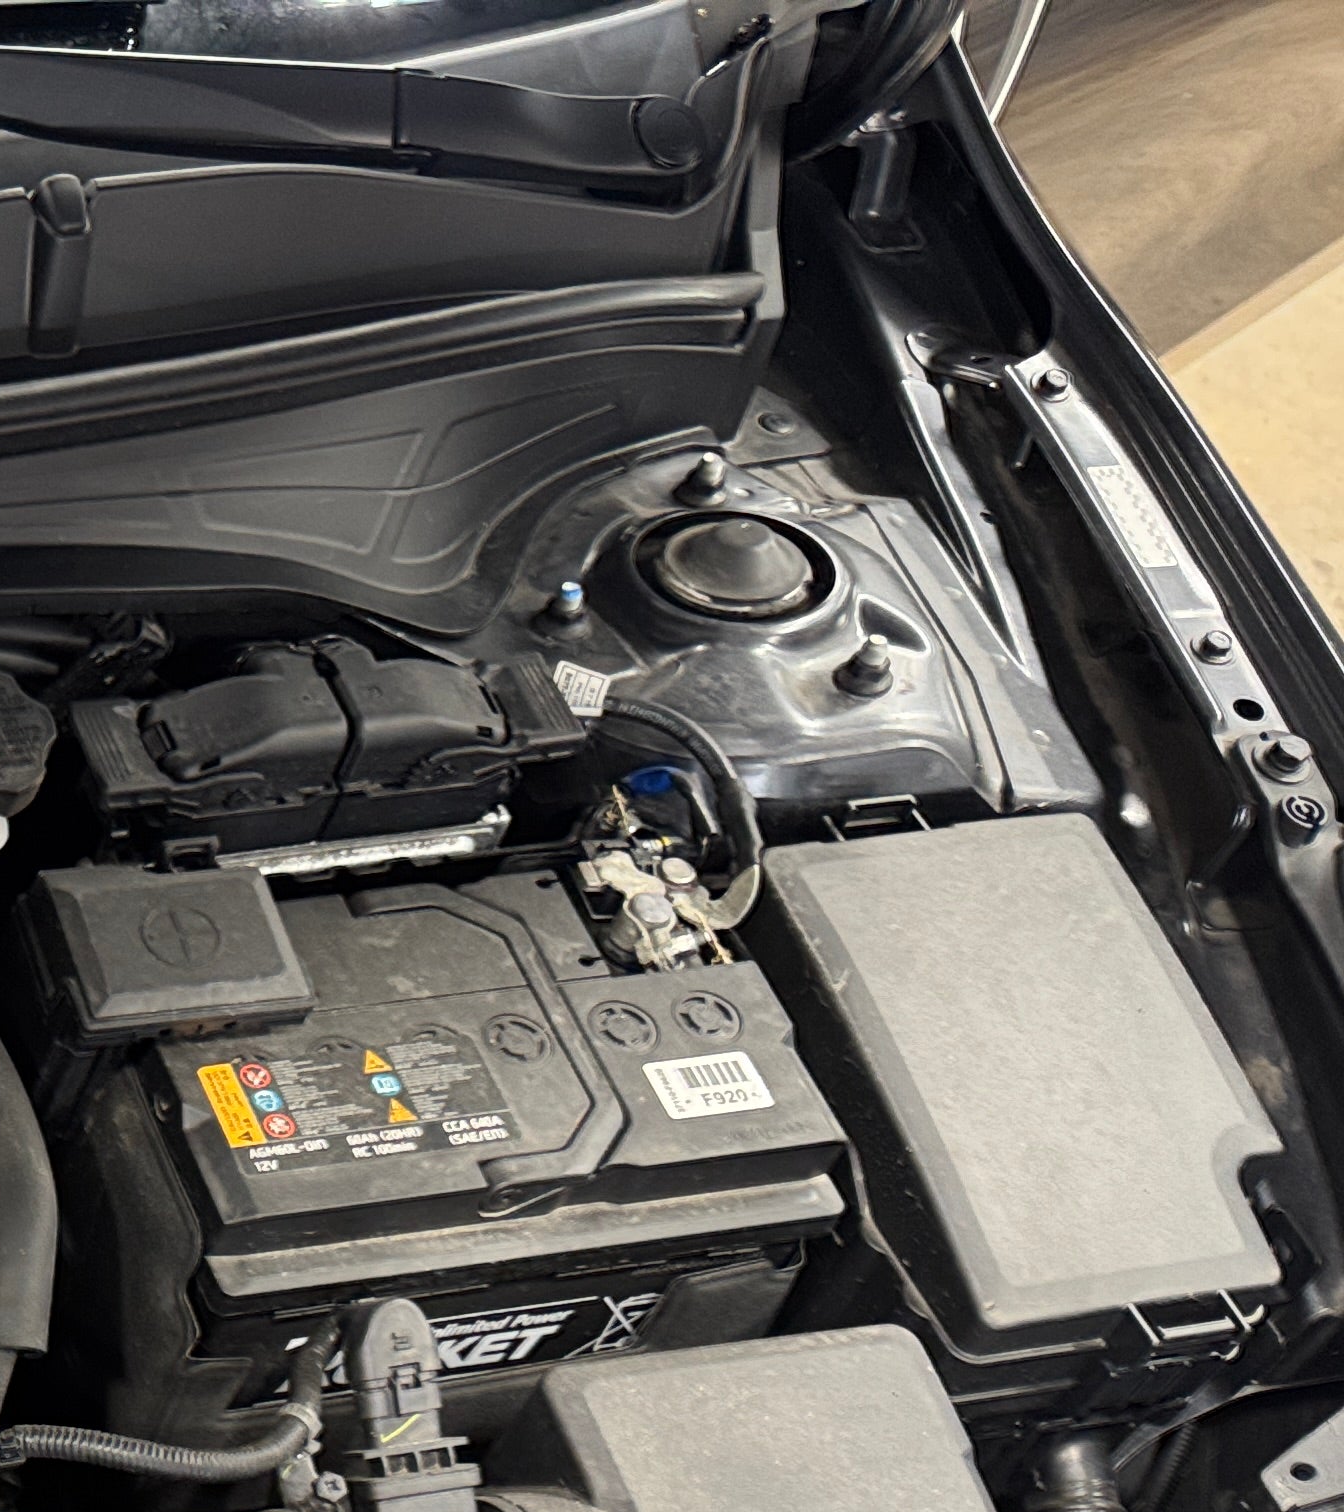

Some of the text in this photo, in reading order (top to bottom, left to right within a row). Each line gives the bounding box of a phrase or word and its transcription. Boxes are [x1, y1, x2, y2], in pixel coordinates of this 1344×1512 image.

[442, 1118, 470, 1133] CCA
[352, 1146, 373, 1159] RC
[254, 1159, 280, 1173] 12V
[431, 1309, 576, 1338] nlimited Power
